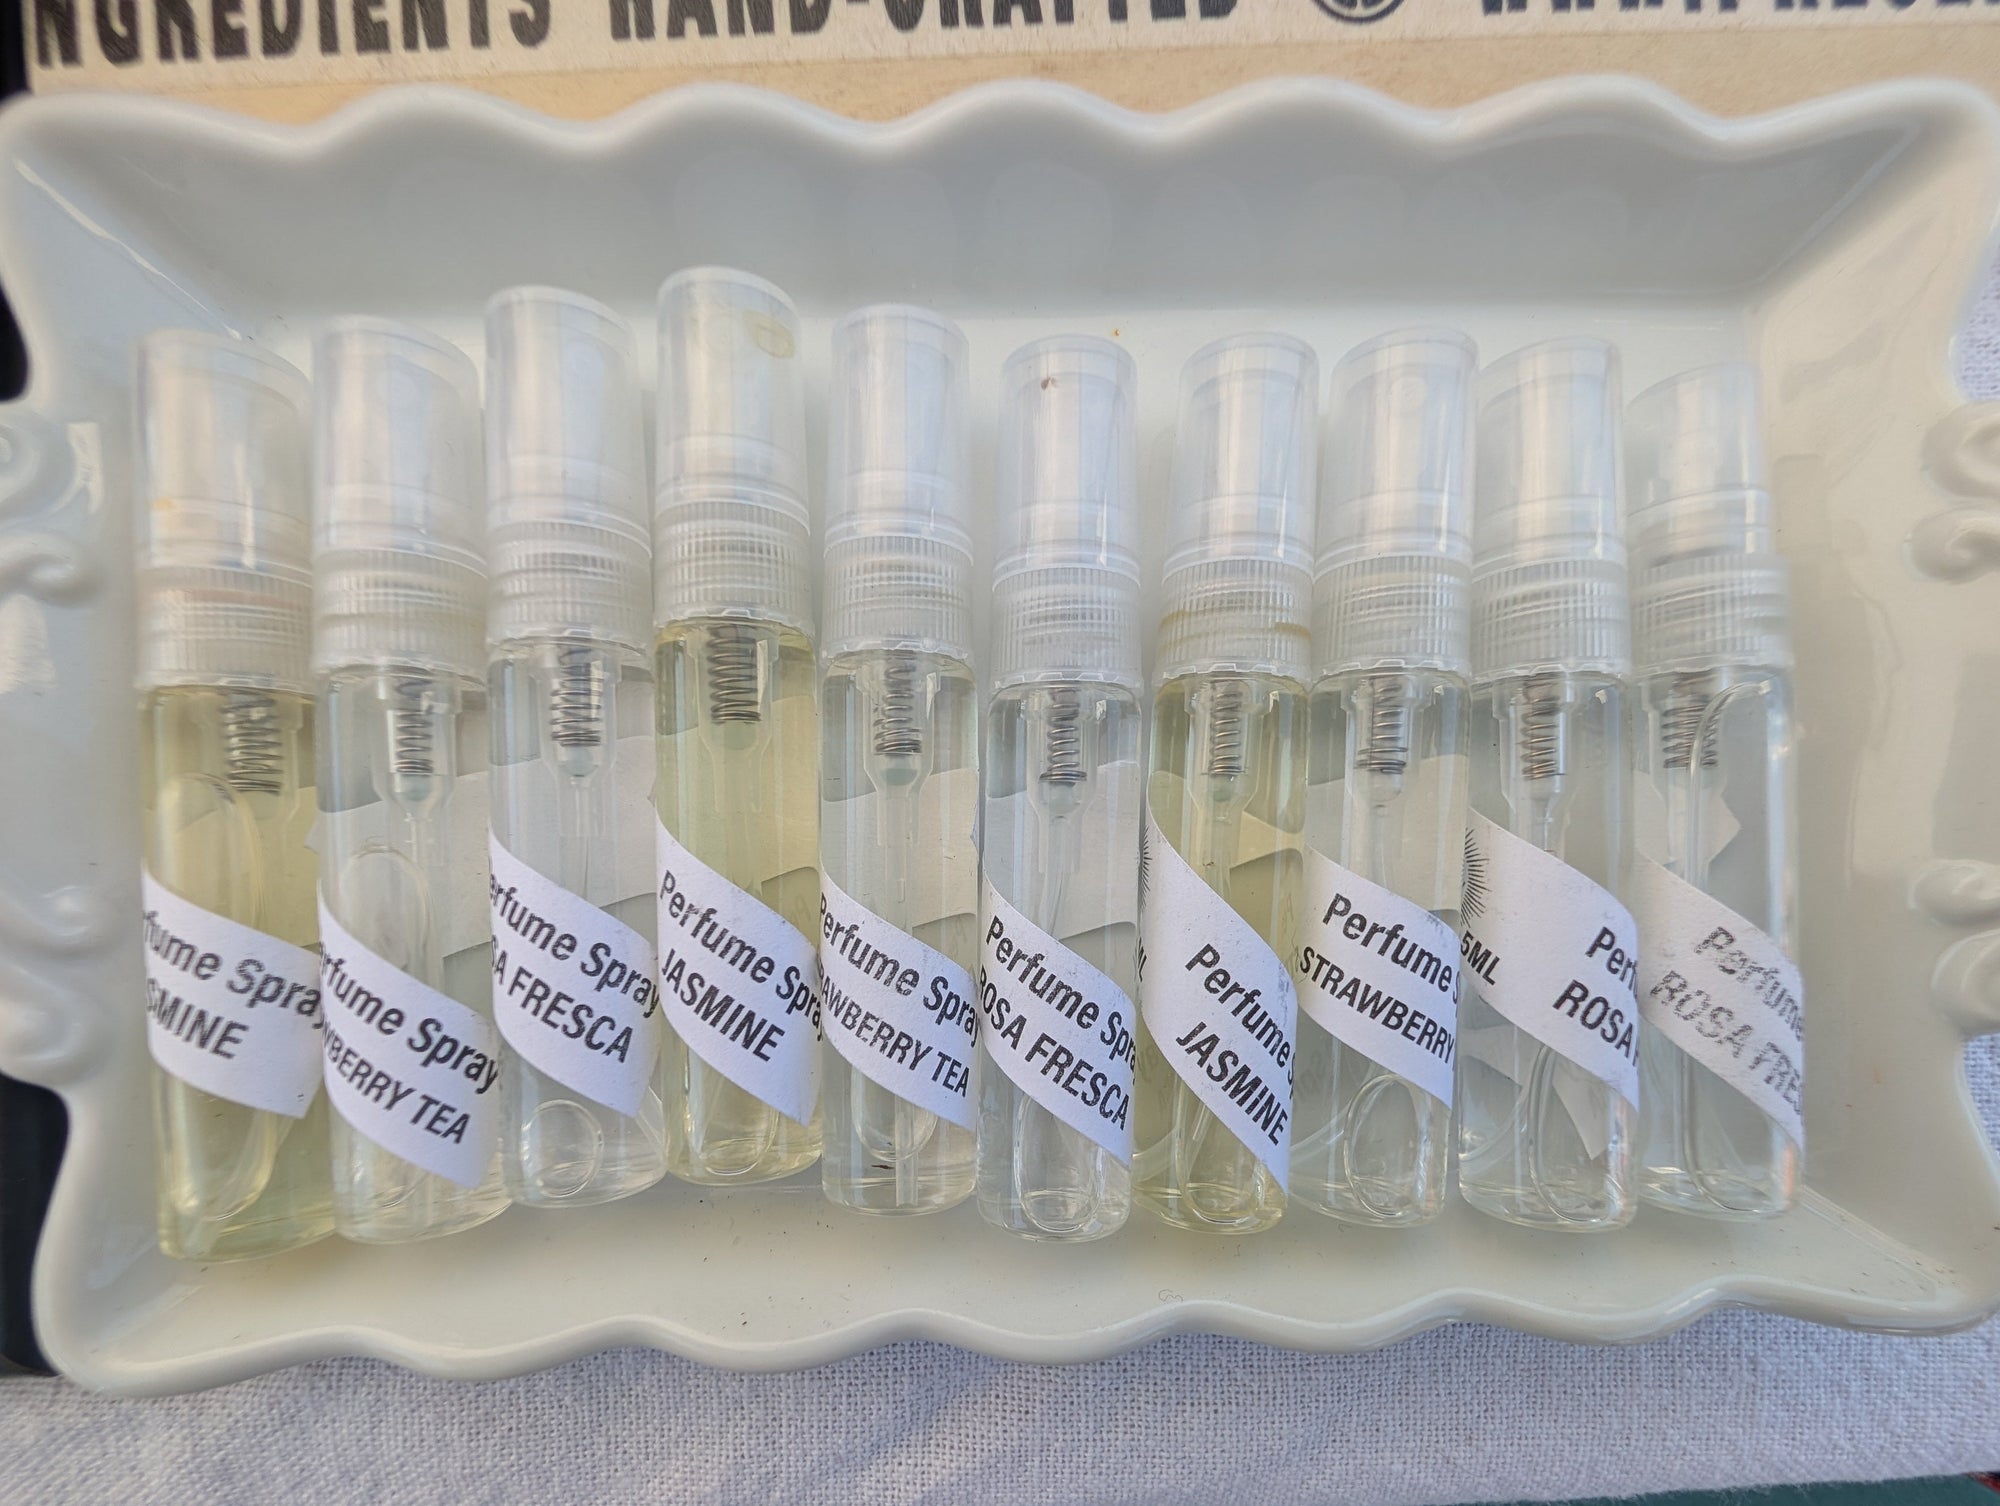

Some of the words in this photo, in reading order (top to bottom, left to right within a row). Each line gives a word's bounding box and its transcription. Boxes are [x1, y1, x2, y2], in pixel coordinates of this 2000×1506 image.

[35, 0, 551, 68] NGREDIENTS
[660, 869, 775, 984] Perfume
[1322, 893, 1453, 993] Perfume
[146, 977, 250, 1060] SMINE
[507, 966, 634, 1064] FRESCA
[580, 942, 660, 1019] Spray
[662, 947, 786, 1062] JASMINE
[985, 915, 1100, 1030] Perfume
[1100, 1011, 1136, 1087] Spra
[1184, 943, 1291, 1069] Perfume
[1300, 946, 1456, 1065] STRAWBERRY
[1552, 979, 1633, 1059] ROSA
[406, 1017, 500, 1095] Spray
[931, 1051, 971, 1098] TEA
[1025, 1032, 1130, 1131] FRESCA
[1175, 1020, 1289, 1147] JASMINE
[410, 1094, 472, 1145] TEA
